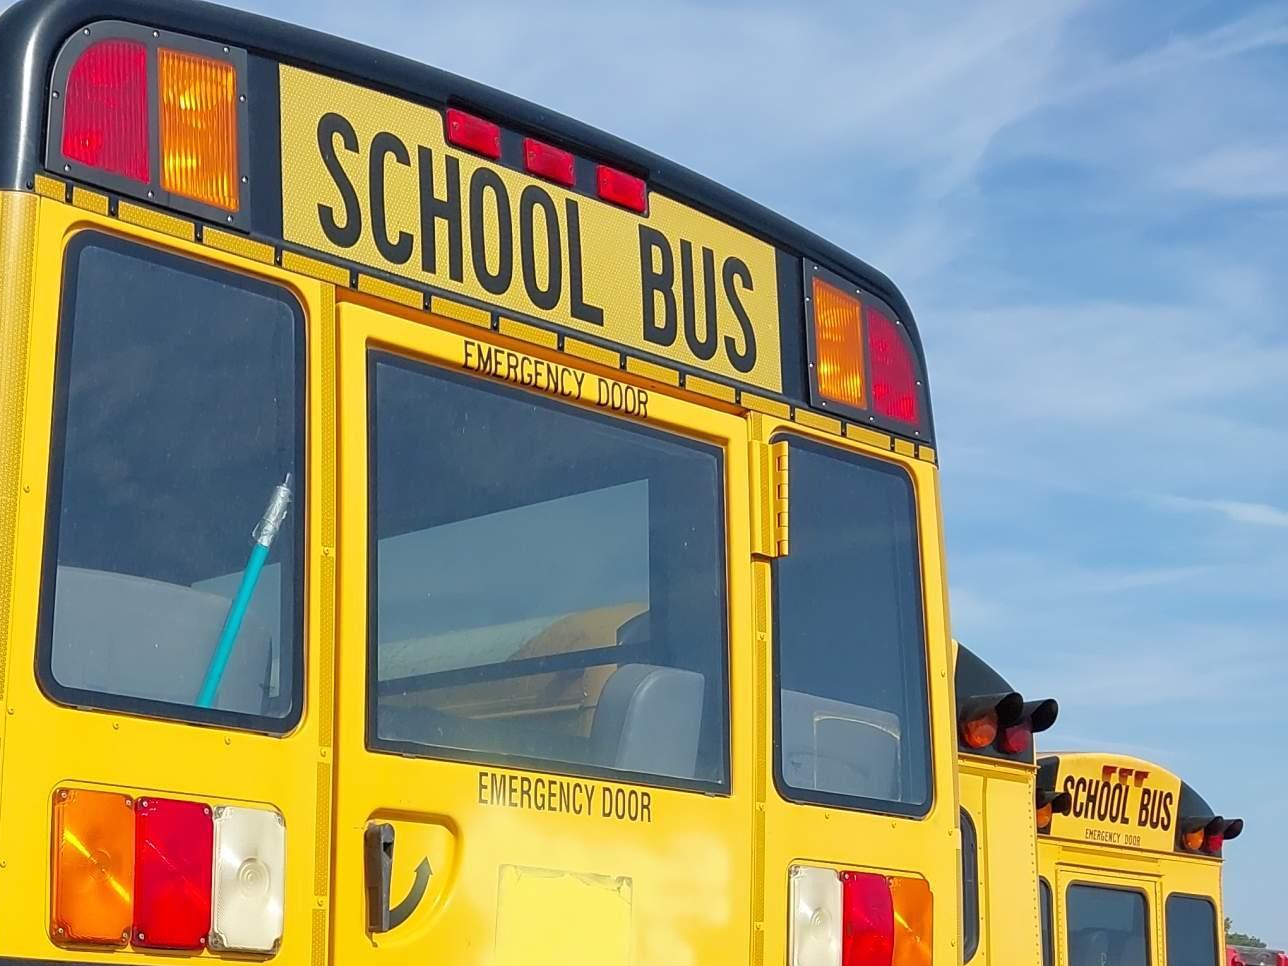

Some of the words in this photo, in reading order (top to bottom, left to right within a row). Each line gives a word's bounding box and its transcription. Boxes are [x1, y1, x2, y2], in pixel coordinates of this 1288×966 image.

[315, 111, 605, 327] SCHOOL
[638, 223, 758, 375] BUS
[462, 339, 585, 400] EMERGENCY
[596, 377, 650, 419] DOOR
[478, 771, 595, 816] EMERGENCY
[601, 786, 652, 823] DOOR
[1061, 774, 1130, 825] SCHOOL
[1137, 787, 1173, 832] BUS
[1085, 828, 1121, 844] EMERGENCY
[1124, 834, 1141, 847] DOOR
